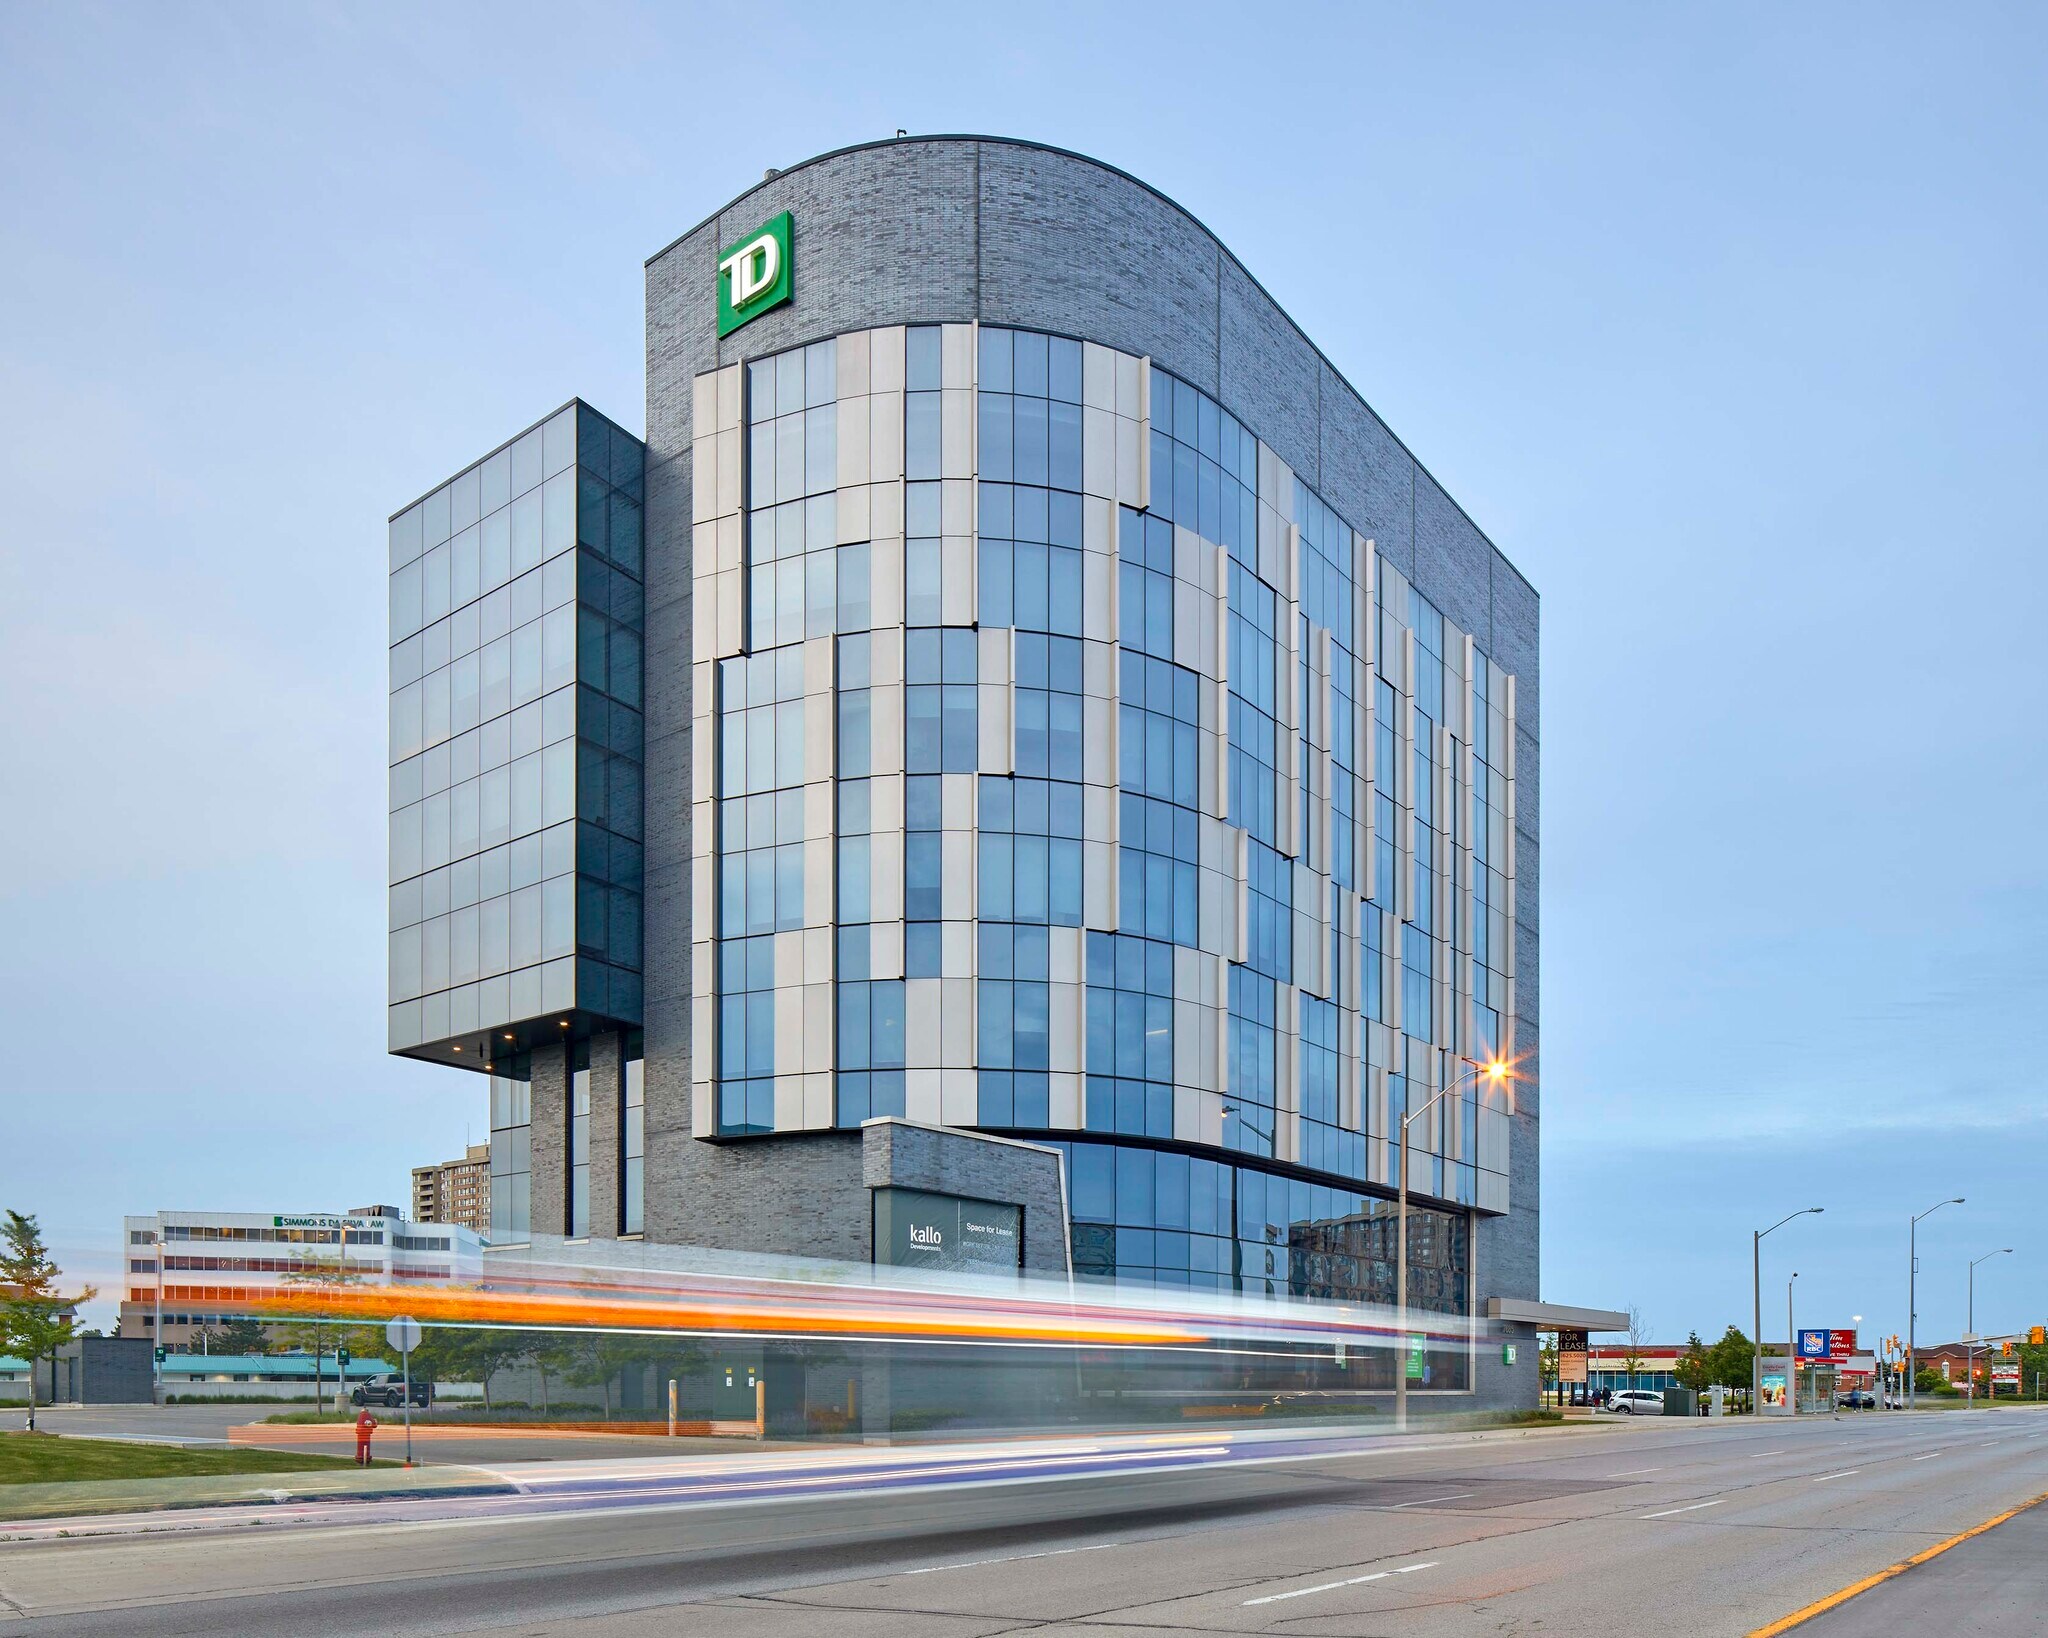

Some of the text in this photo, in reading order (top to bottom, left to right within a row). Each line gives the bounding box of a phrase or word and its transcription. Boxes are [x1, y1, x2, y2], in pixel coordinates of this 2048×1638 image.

[719, 234, 780, 310] TD
[283, 1218, 327, 1227] SIMMONS
[366, 1220, 385, 1228] LAW
[910, 1224, 942, 1244] kallo
[966, 1222, 1013, 1237] Space for Lease
[910, 1243, 942, 1252] Developments
[1560, 1333, 1578, 1341] FOR
[1560, 1342, 1587, 1350] LEASE
[1829, 1341, 1850, 1349] rtons
